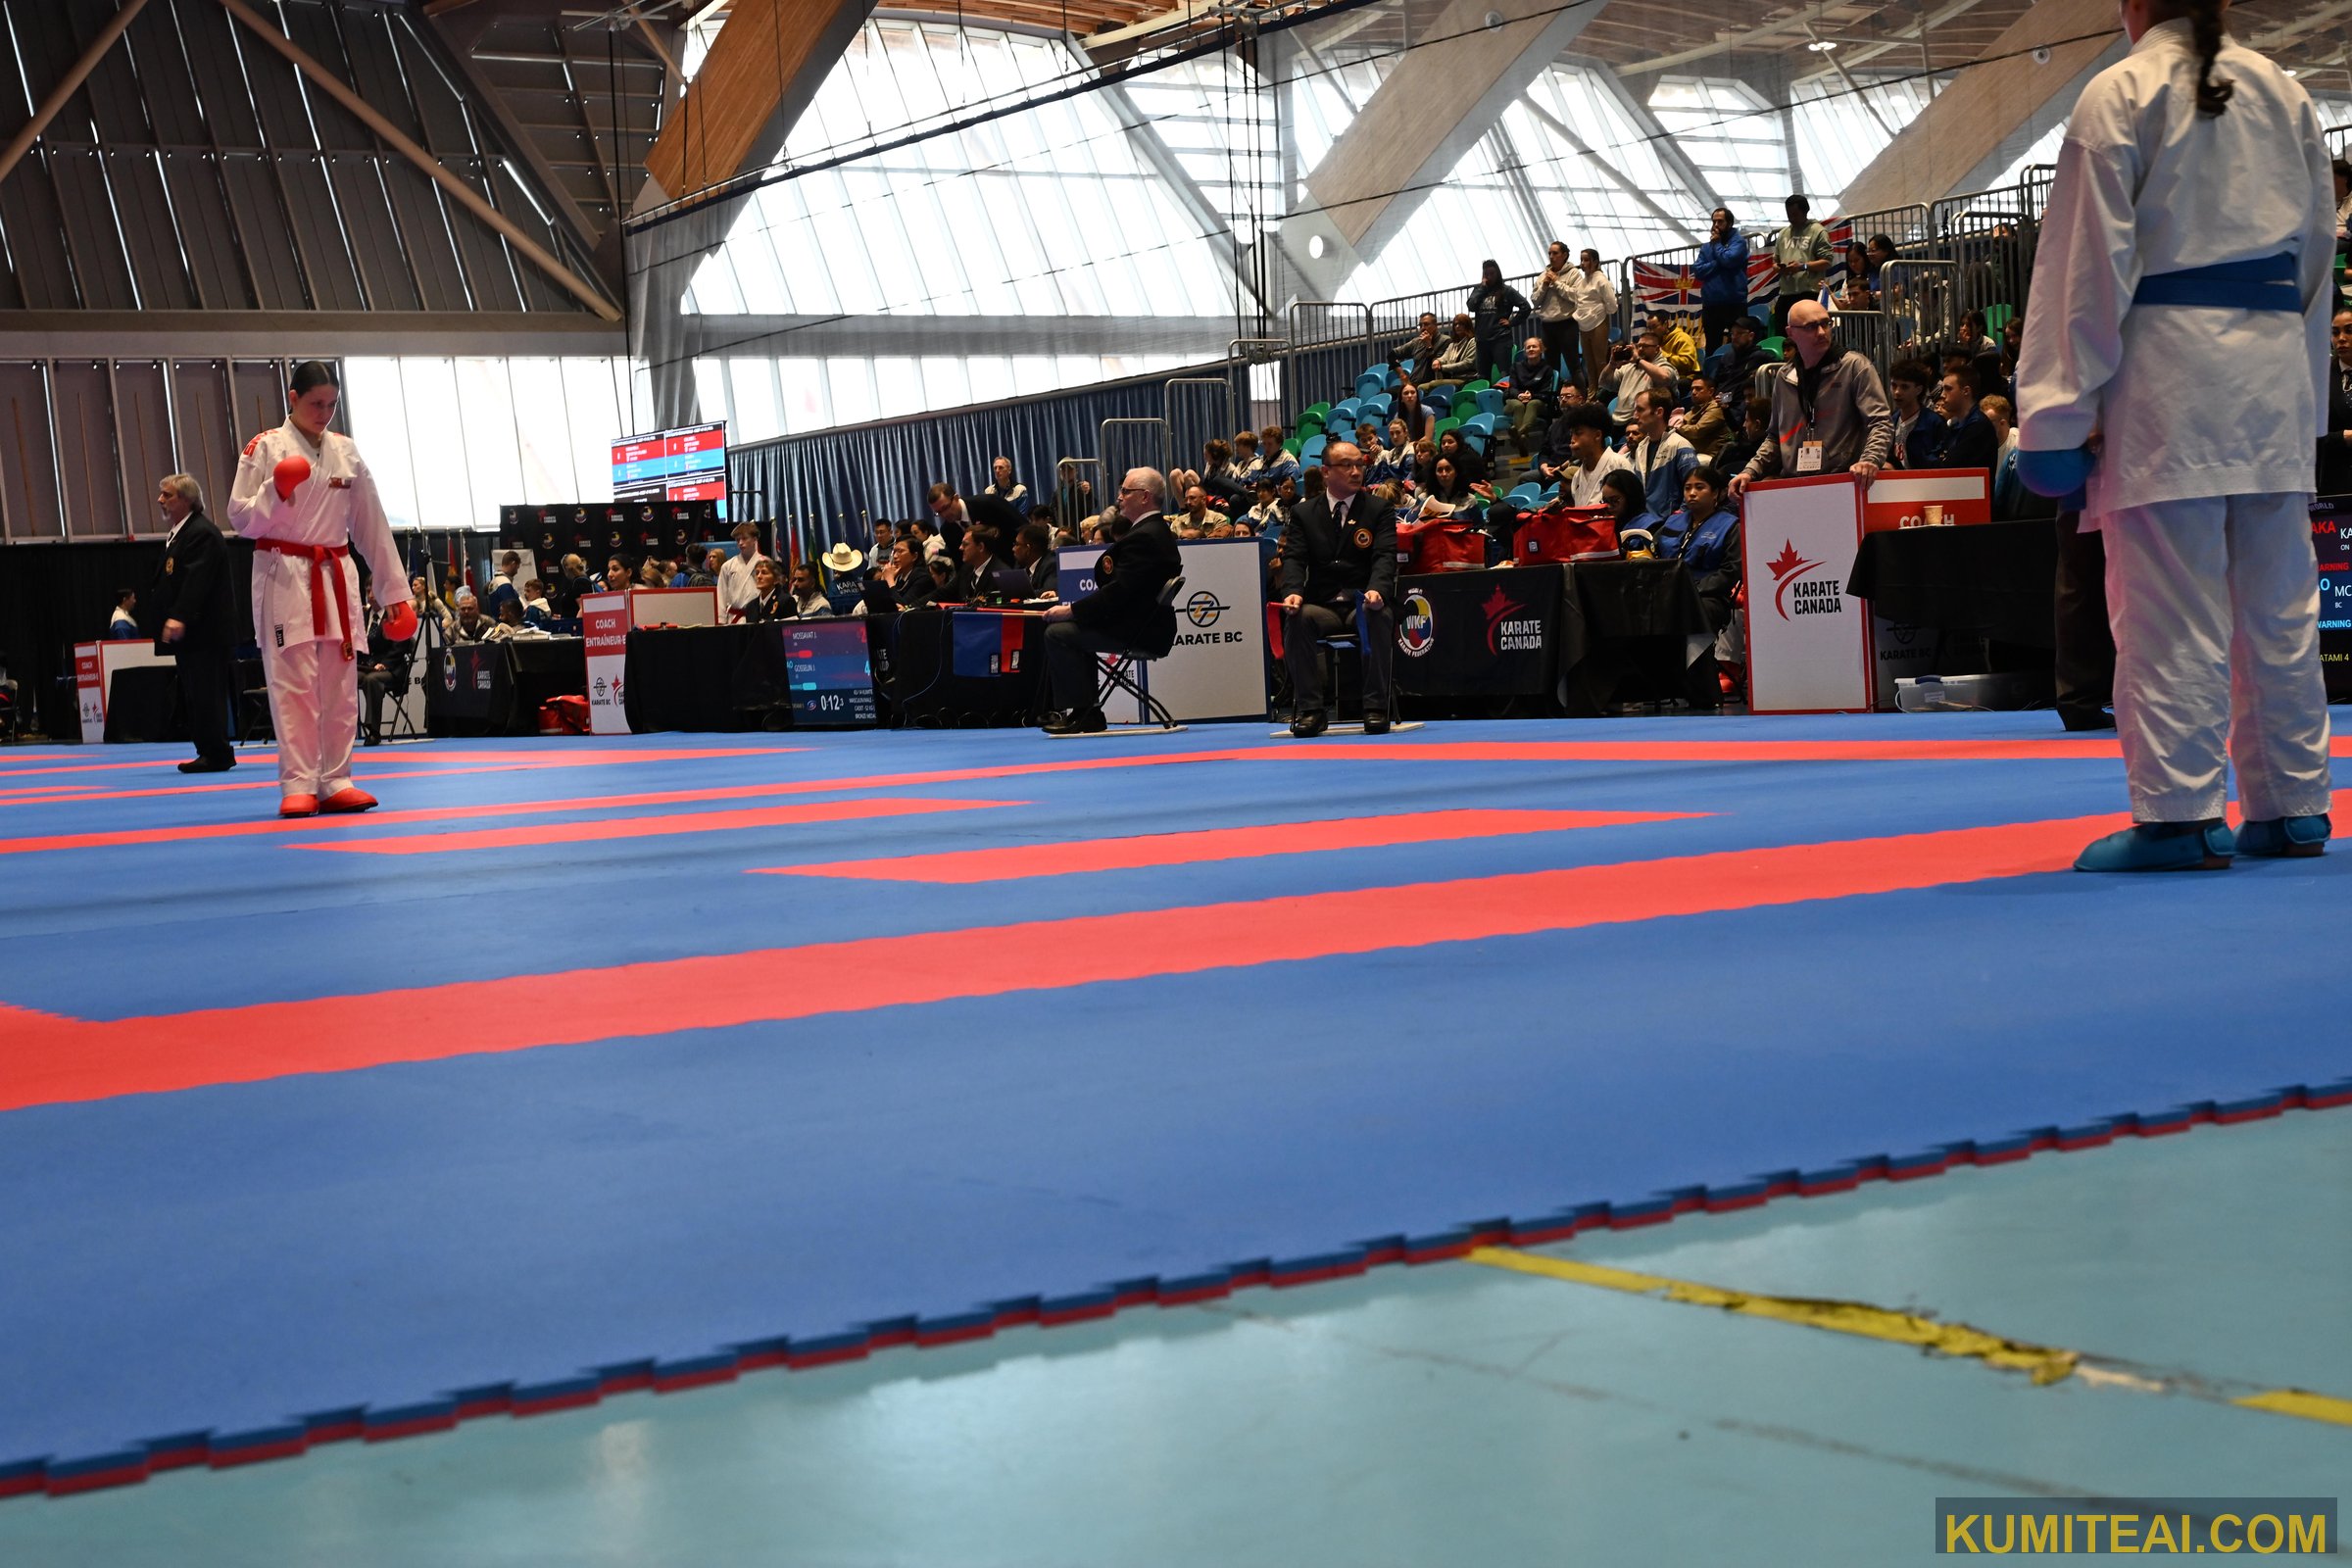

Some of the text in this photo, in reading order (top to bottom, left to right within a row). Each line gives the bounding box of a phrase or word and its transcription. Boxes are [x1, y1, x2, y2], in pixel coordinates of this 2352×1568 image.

[1784, 236, 1810, 250] VANS
[1899, 514, 1955, 527] COH
[2311, 519, 2337, 534] AKA
[2319, 563, 2350, 571] ARNING
[1079, 578, 1099, 591] COA
[1793, 580, 1840, 598] KARATE
[2319, 577, 2331, 591] O
[1794, 598, 1842, 614] CANADA
[595, 617, 616, 630] COACH
[1405, 614, 1427, 630] WKF
[1500, 619, 1542, 636] KARATE
[1174, 631, 1243, 646] ARATE BC
[1500, 635, 1543, 651] CANADA
[1880, 648, 1917, 661] KARATE
[2319, 653, 2350, 662] ATAMI 4
[864, 660, 871, 676] 4
